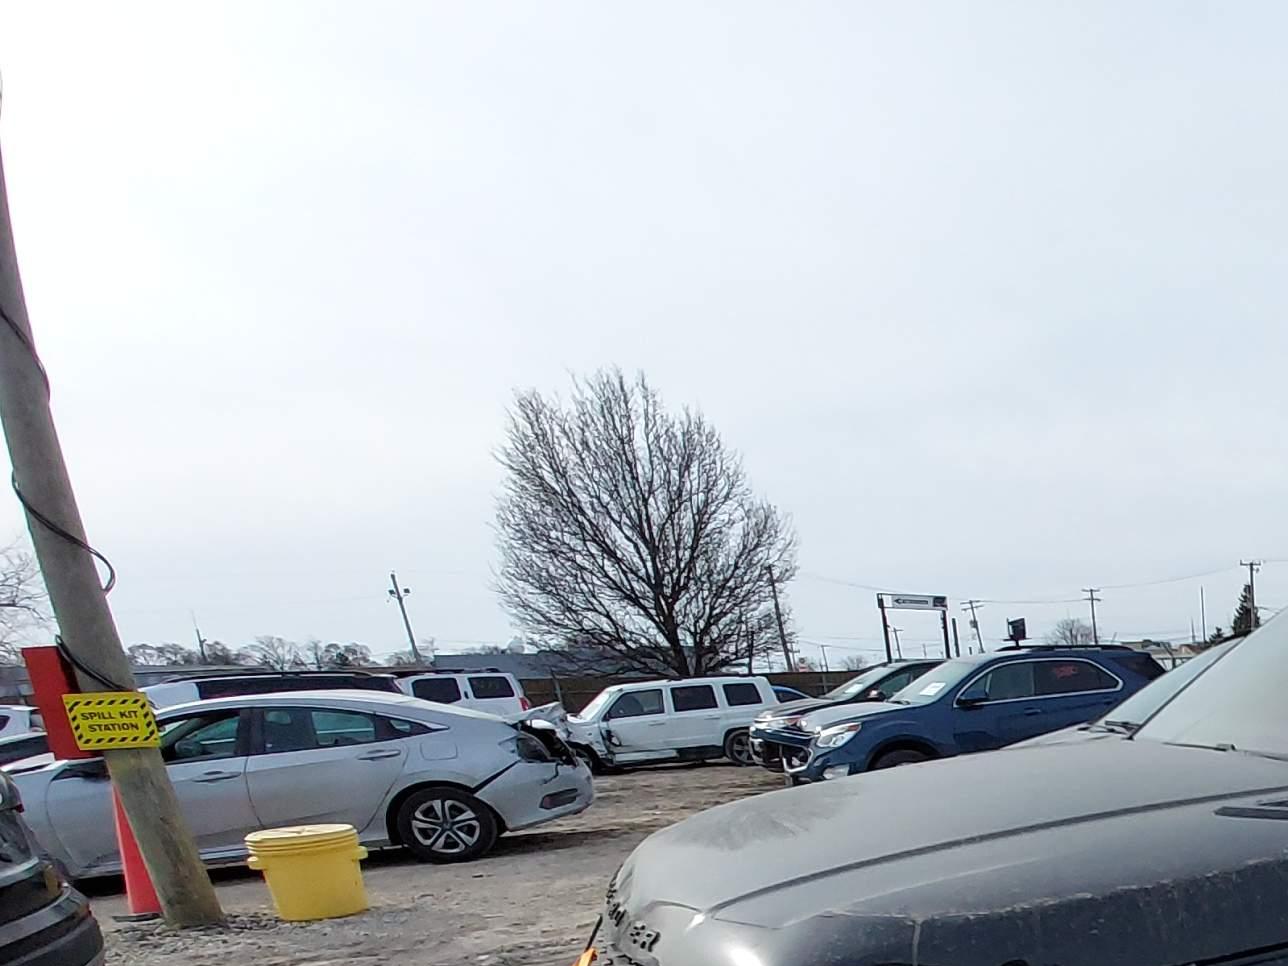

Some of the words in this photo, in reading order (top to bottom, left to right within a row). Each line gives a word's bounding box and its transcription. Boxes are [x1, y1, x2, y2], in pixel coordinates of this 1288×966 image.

[81, 711, 116, 720] SPILL
[119, 710, 138, 719] KIT
[88, 722, 139, 732] STATION
